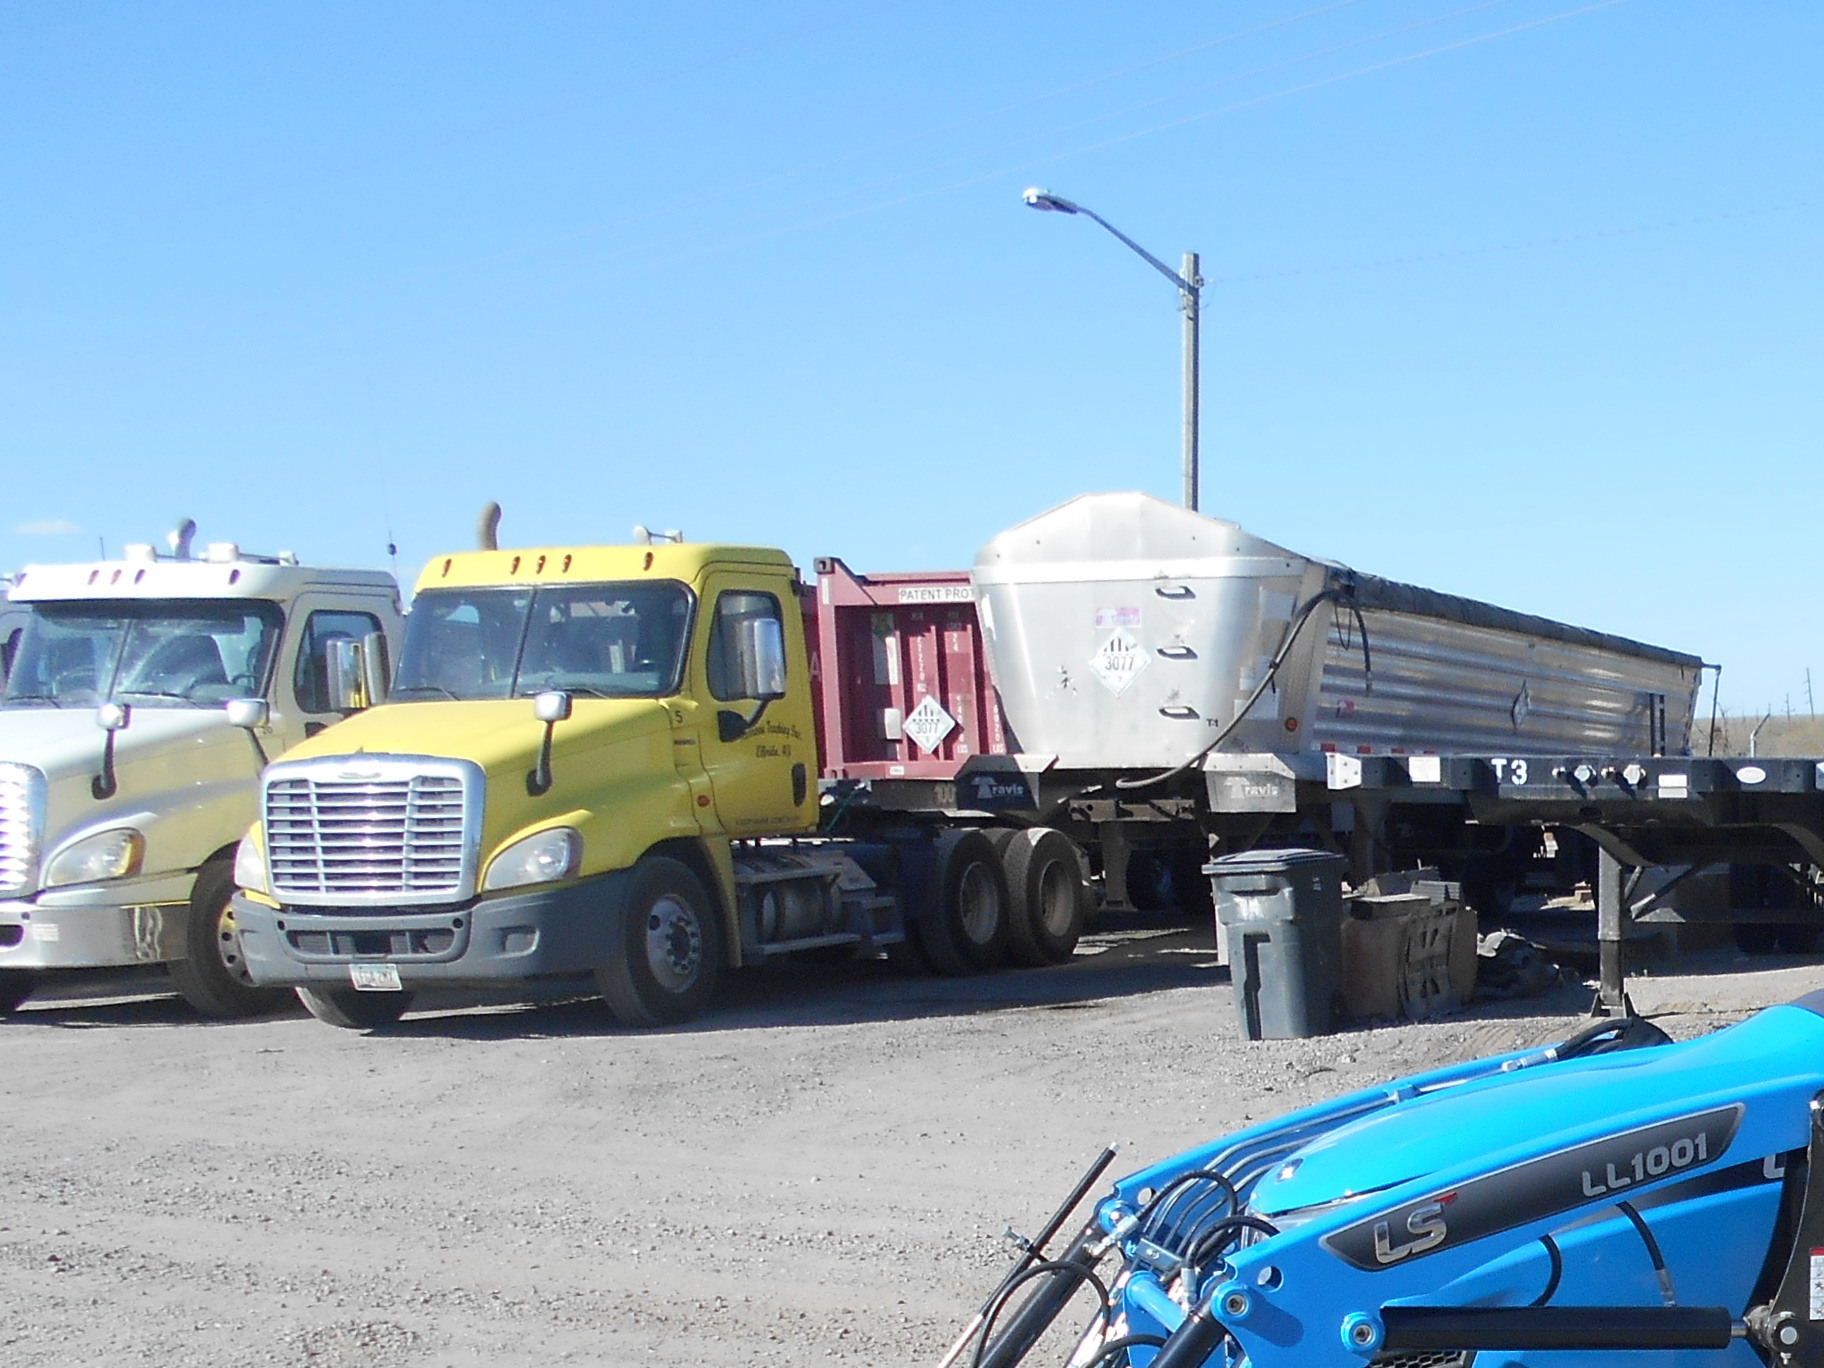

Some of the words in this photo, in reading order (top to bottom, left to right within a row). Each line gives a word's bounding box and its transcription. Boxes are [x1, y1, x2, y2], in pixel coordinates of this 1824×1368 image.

[900, 589, 941, 601] PATENT
[1104, 655, 1135, 672] 3077
[674, 710, 684, 724] 5
[915, 722, 939, 735] 3077
[971, 776, 1025, 799] Travis
[1223, 777, 1279, 799] Travis
[1582, 1132, 1708, 1198] LL1001
[1374, 1201, 1448, 1265] LS
